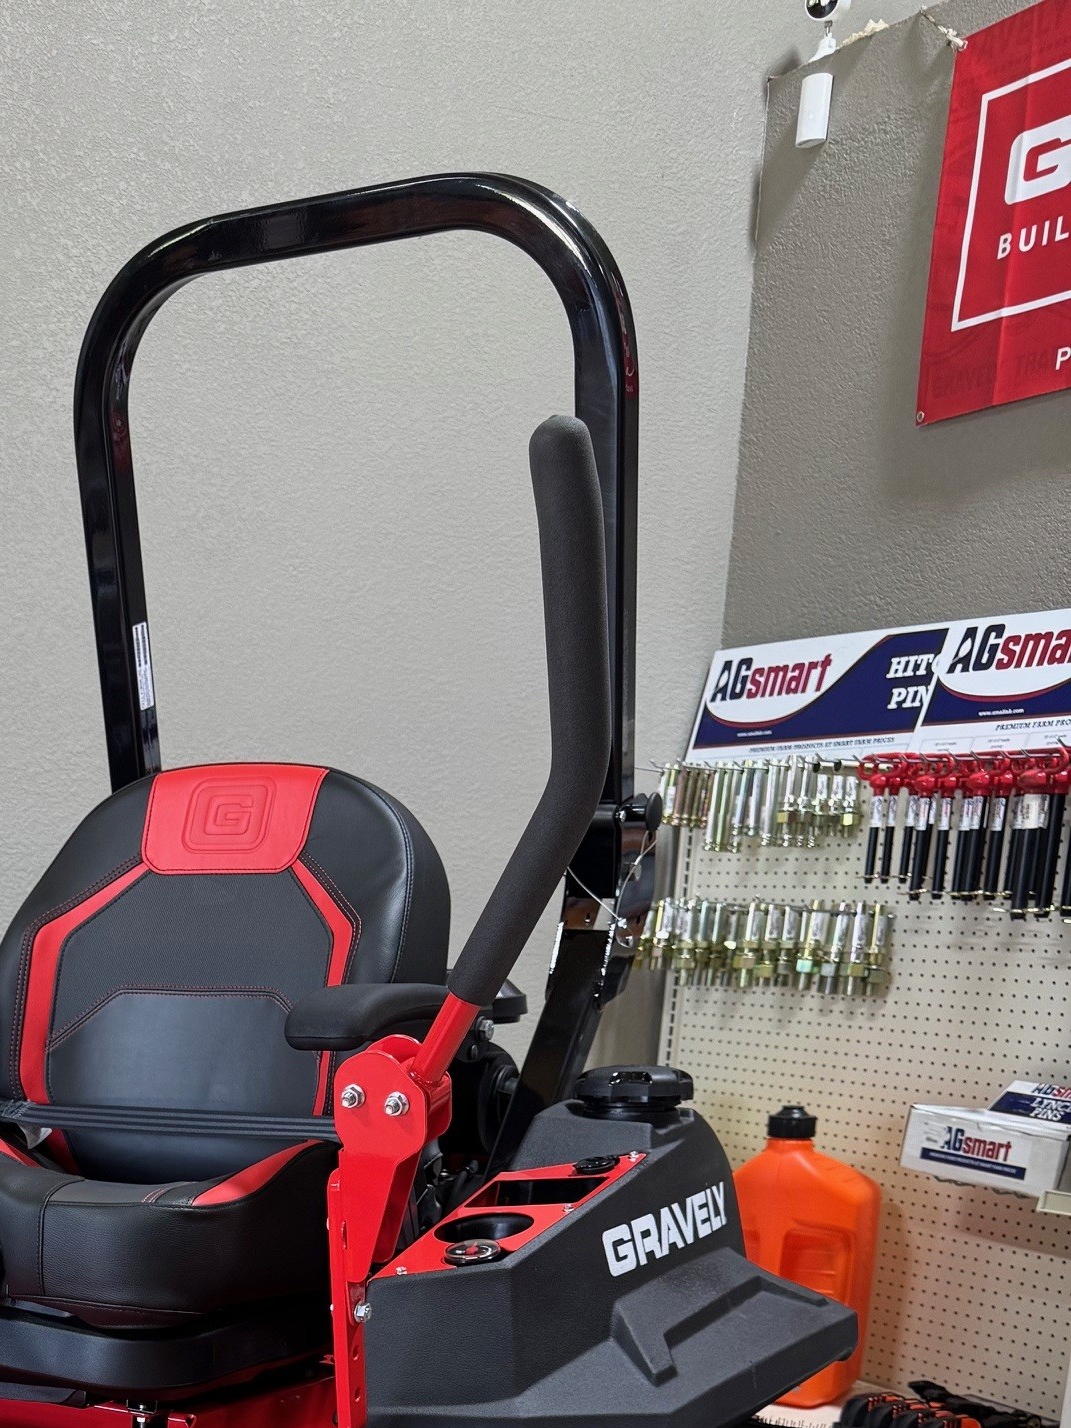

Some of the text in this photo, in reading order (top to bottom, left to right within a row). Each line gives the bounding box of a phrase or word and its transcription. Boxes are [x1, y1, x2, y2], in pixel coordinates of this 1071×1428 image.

[997, 215, 1070, 260] BUIL
[946, 623, 1071, 674] AGsma
[710, 653, 833, 703] AGsmart
[1029, 1108, 1065, 1121] PINS
[940, 1126, 1012, 1162] AGsmart
[602, 1181, 728, 1277] GRAVELY
